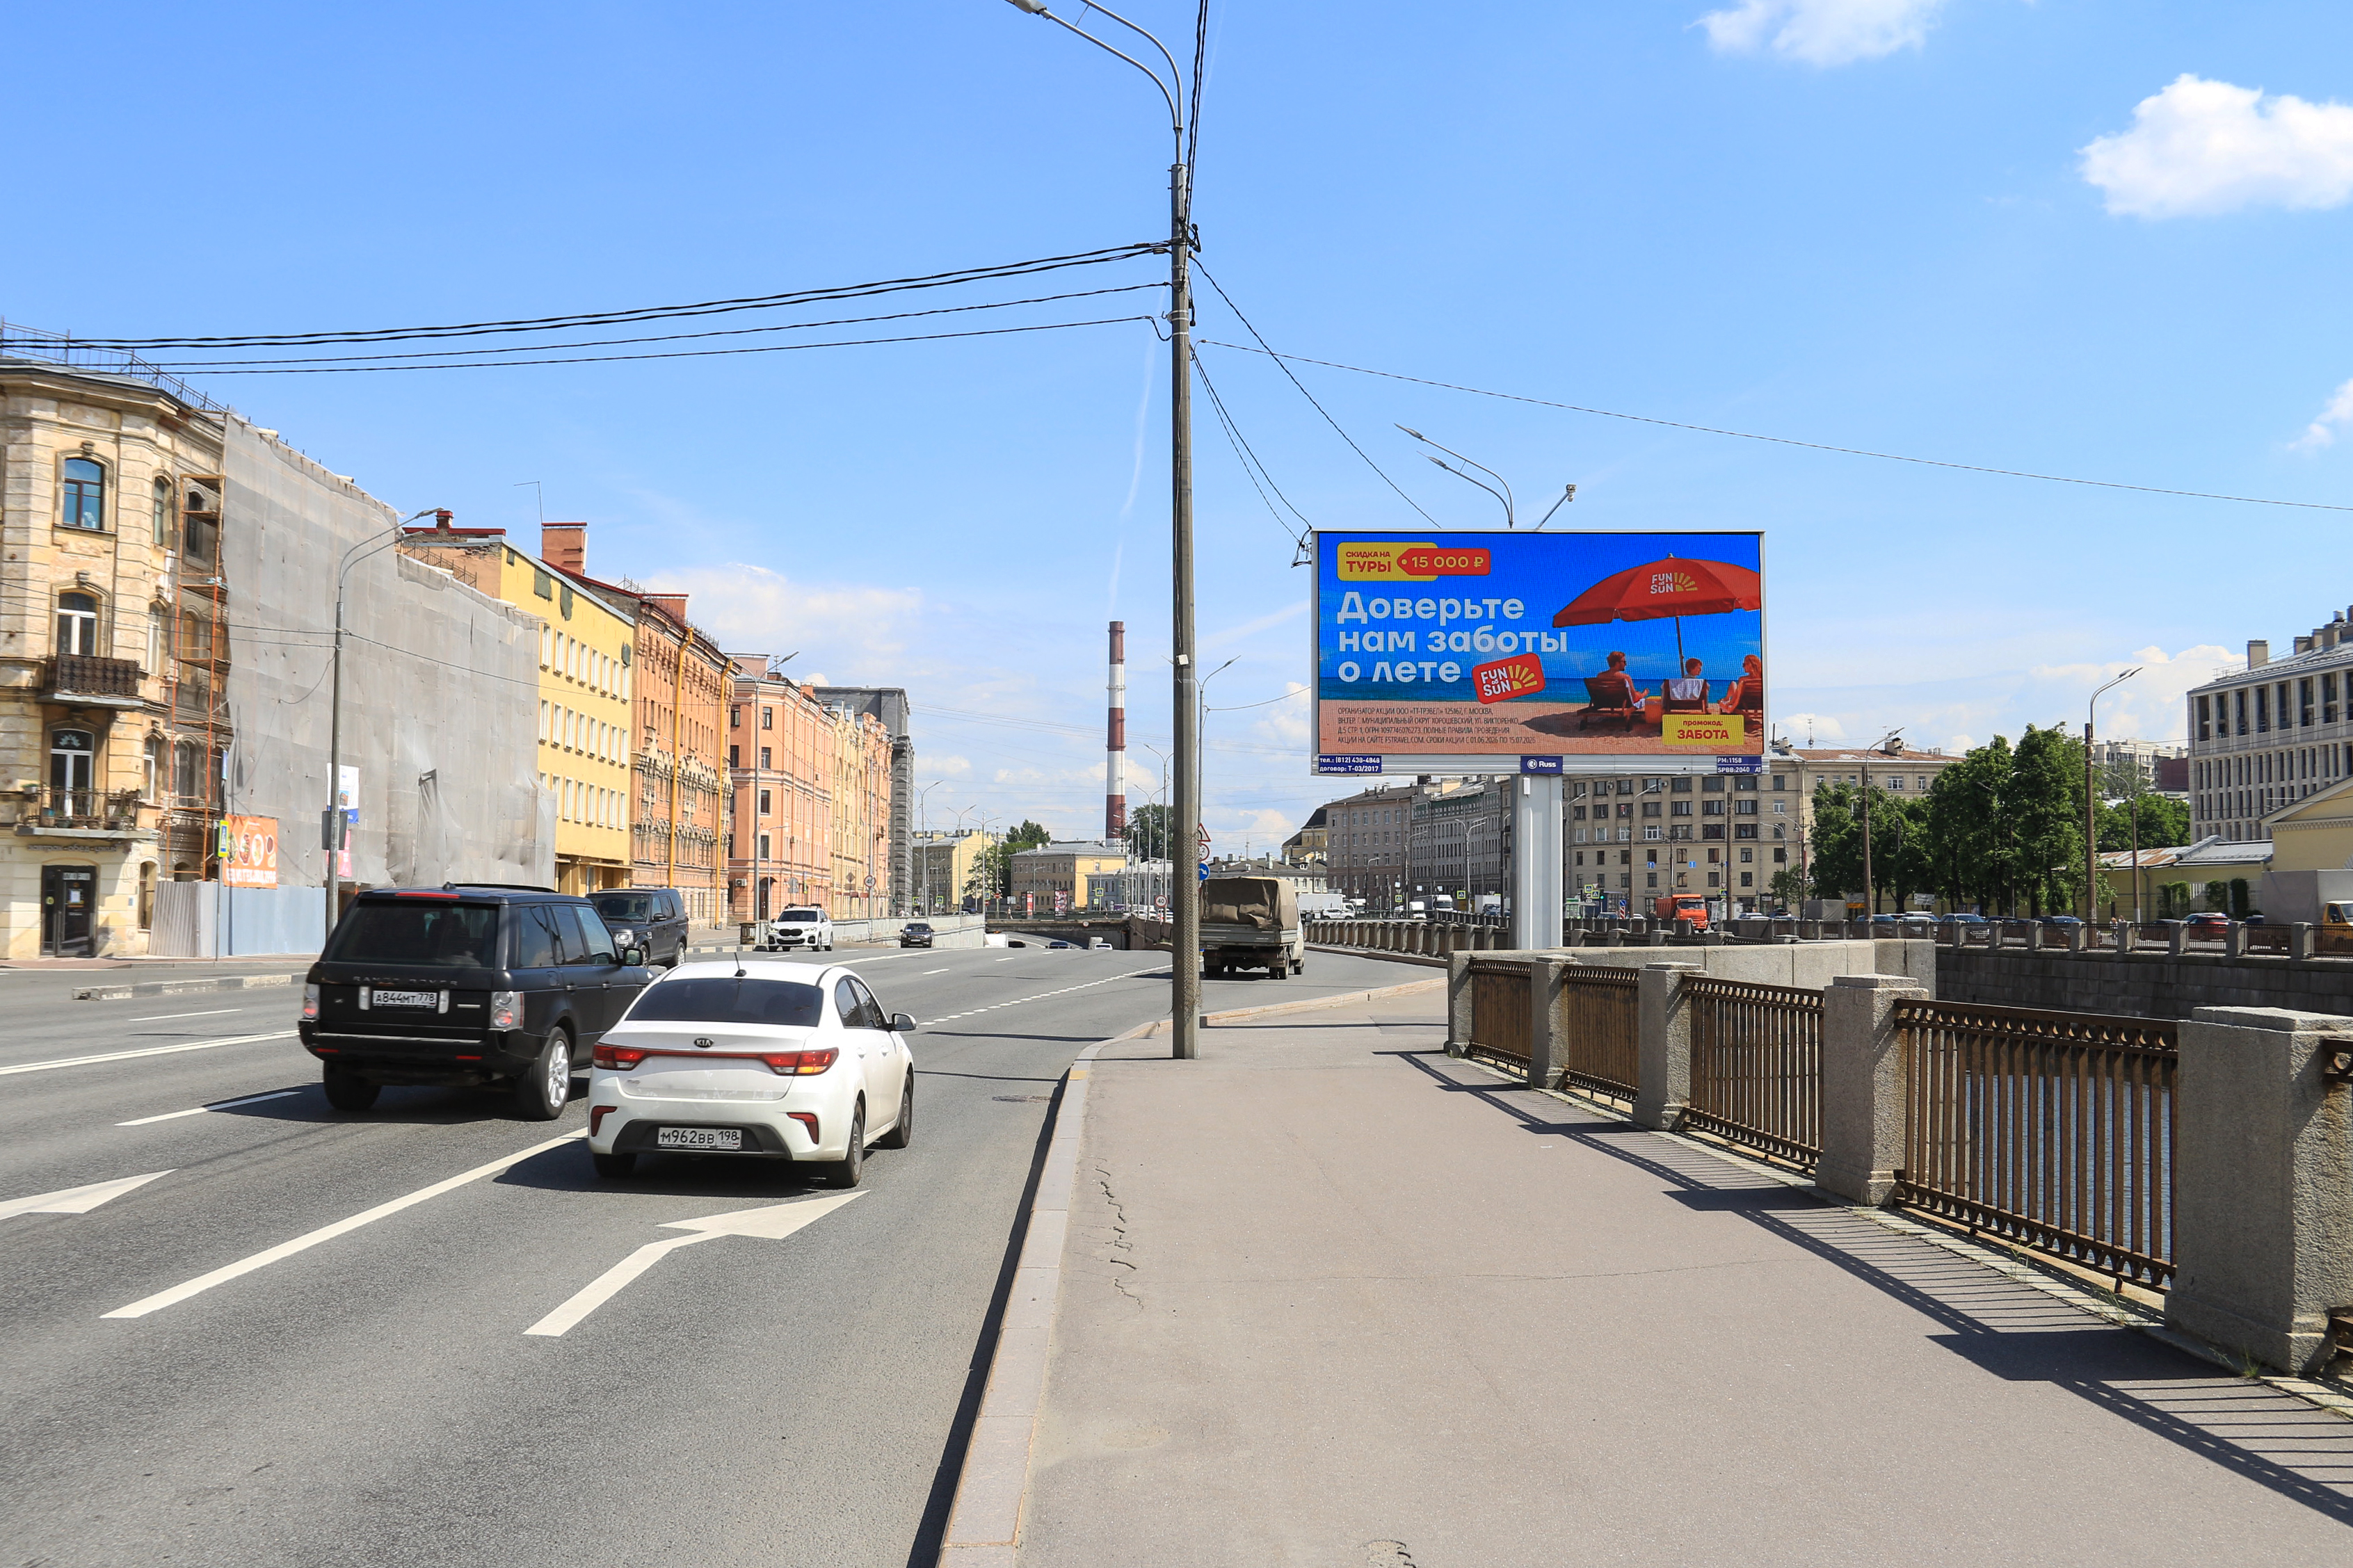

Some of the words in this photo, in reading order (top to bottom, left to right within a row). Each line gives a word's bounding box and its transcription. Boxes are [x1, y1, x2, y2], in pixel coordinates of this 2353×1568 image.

[1346, 561, 1391, 572] ТУРЫ
[1411, 556, 1428, 567] 15
[1434, 556, 1469, 568] 000
[1652, 572, 1673, 584] FUN
[1651, 583, 1673, 594] SUN
[1337, 591, 1525, 626] Доверьте
[1339, 631, 1416, 652] нам
[1427, 624, 1568, 652] заботы
[1338, 661, 1360, 682] о
[1372, 661, 1461, 683] лете
[1480, 667, 1508, 684] FUN
[1483, 679, 1511, 697] SUN
[1363, 716, 1413, 725] МУНИЦИПАЛЬНЫЙ
[1677, 729, 1729, 739] ЗАБОТА
[376, 992, 416, 1003] А844МТ
[419, 993, 435, 1001] 778
[660, 1129, 715, 1144] М962ВВ
[718, 1131, 739, 1140] 198
